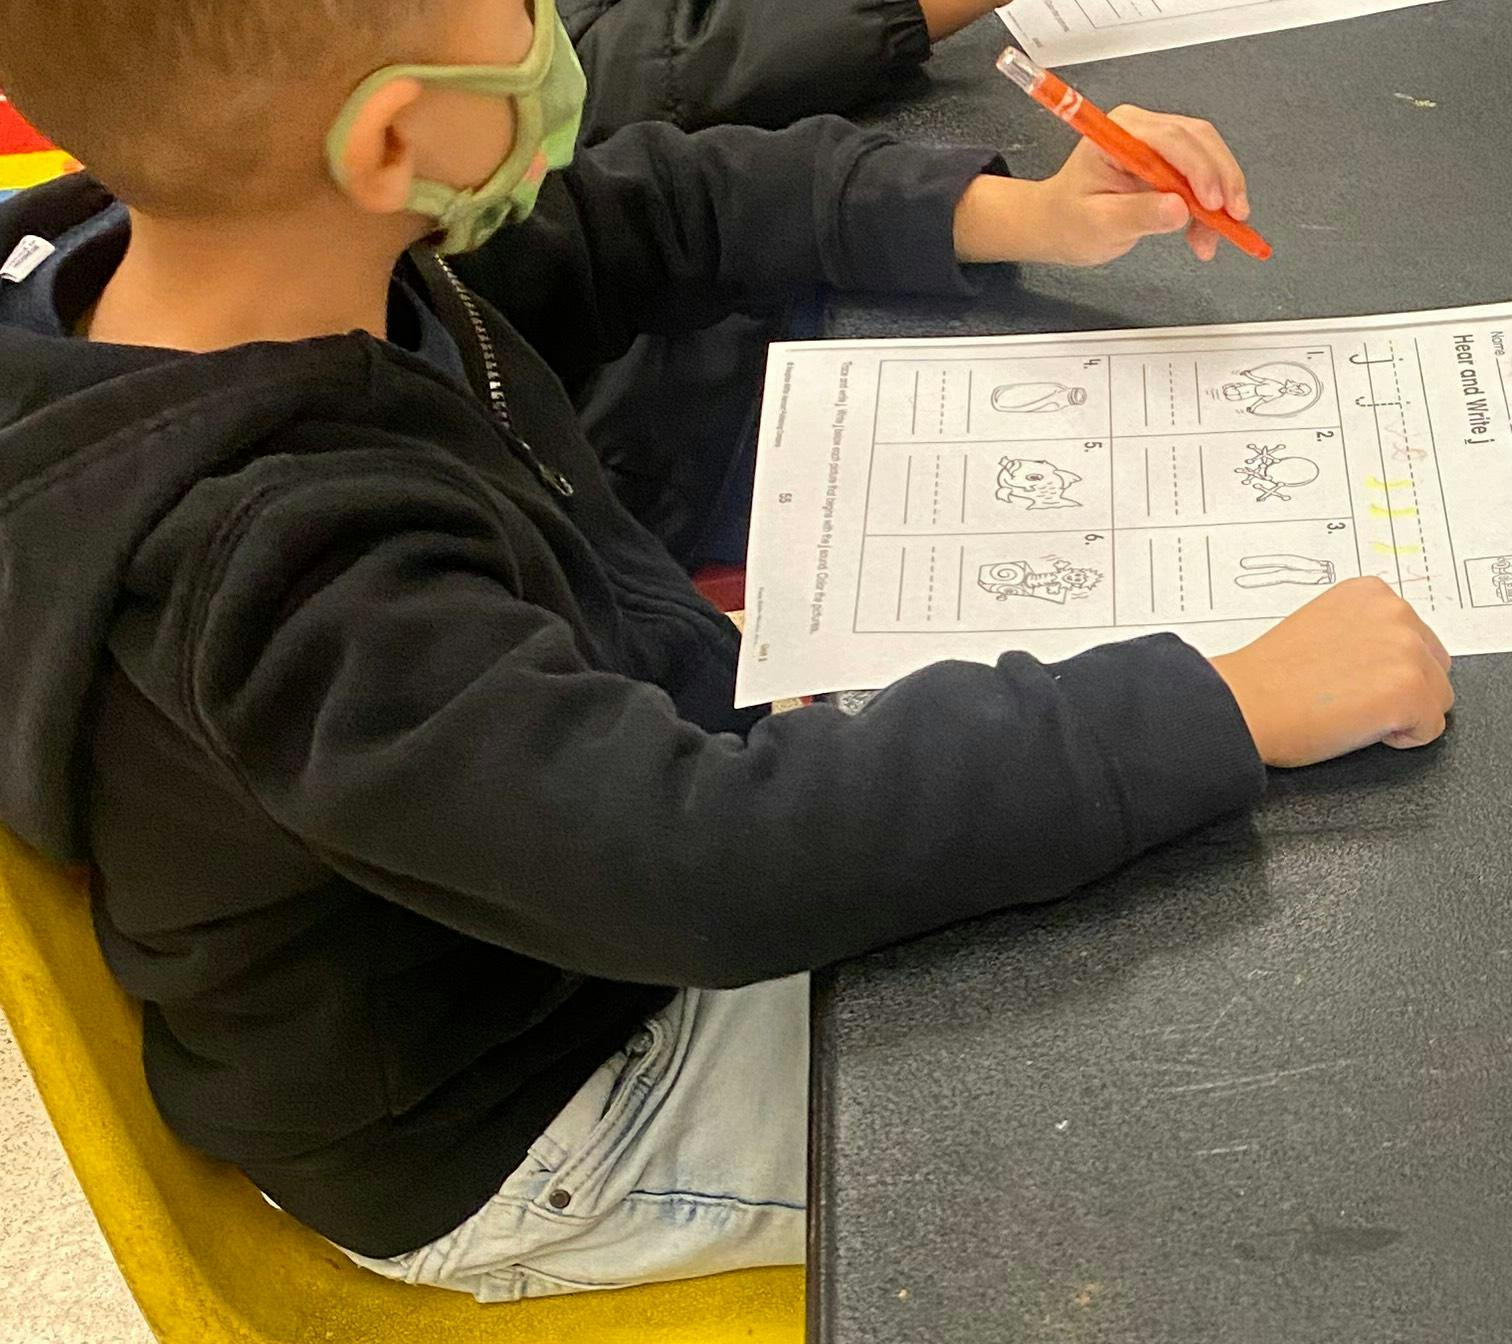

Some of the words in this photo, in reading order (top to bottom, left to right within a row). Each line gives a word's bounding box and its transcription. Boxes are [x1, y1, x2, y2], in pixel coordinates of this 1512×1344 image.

[1453, 334, 1476, 365] Hear
[1490, 330, 1506, 357] Name
[1306, 350, 1325, 360] 1.
[1083, 358, 1101, 369] 4.
[1459, 367, 1485, 394] and
[1466, 398, 1492, 435] Write
[1315, 430, 1335, 442] 2.
[1084, 440, 1103, 453] 5.
[1326, 522, 1346, 535] 3.
[1084, 533, 1105, 546] 6.
